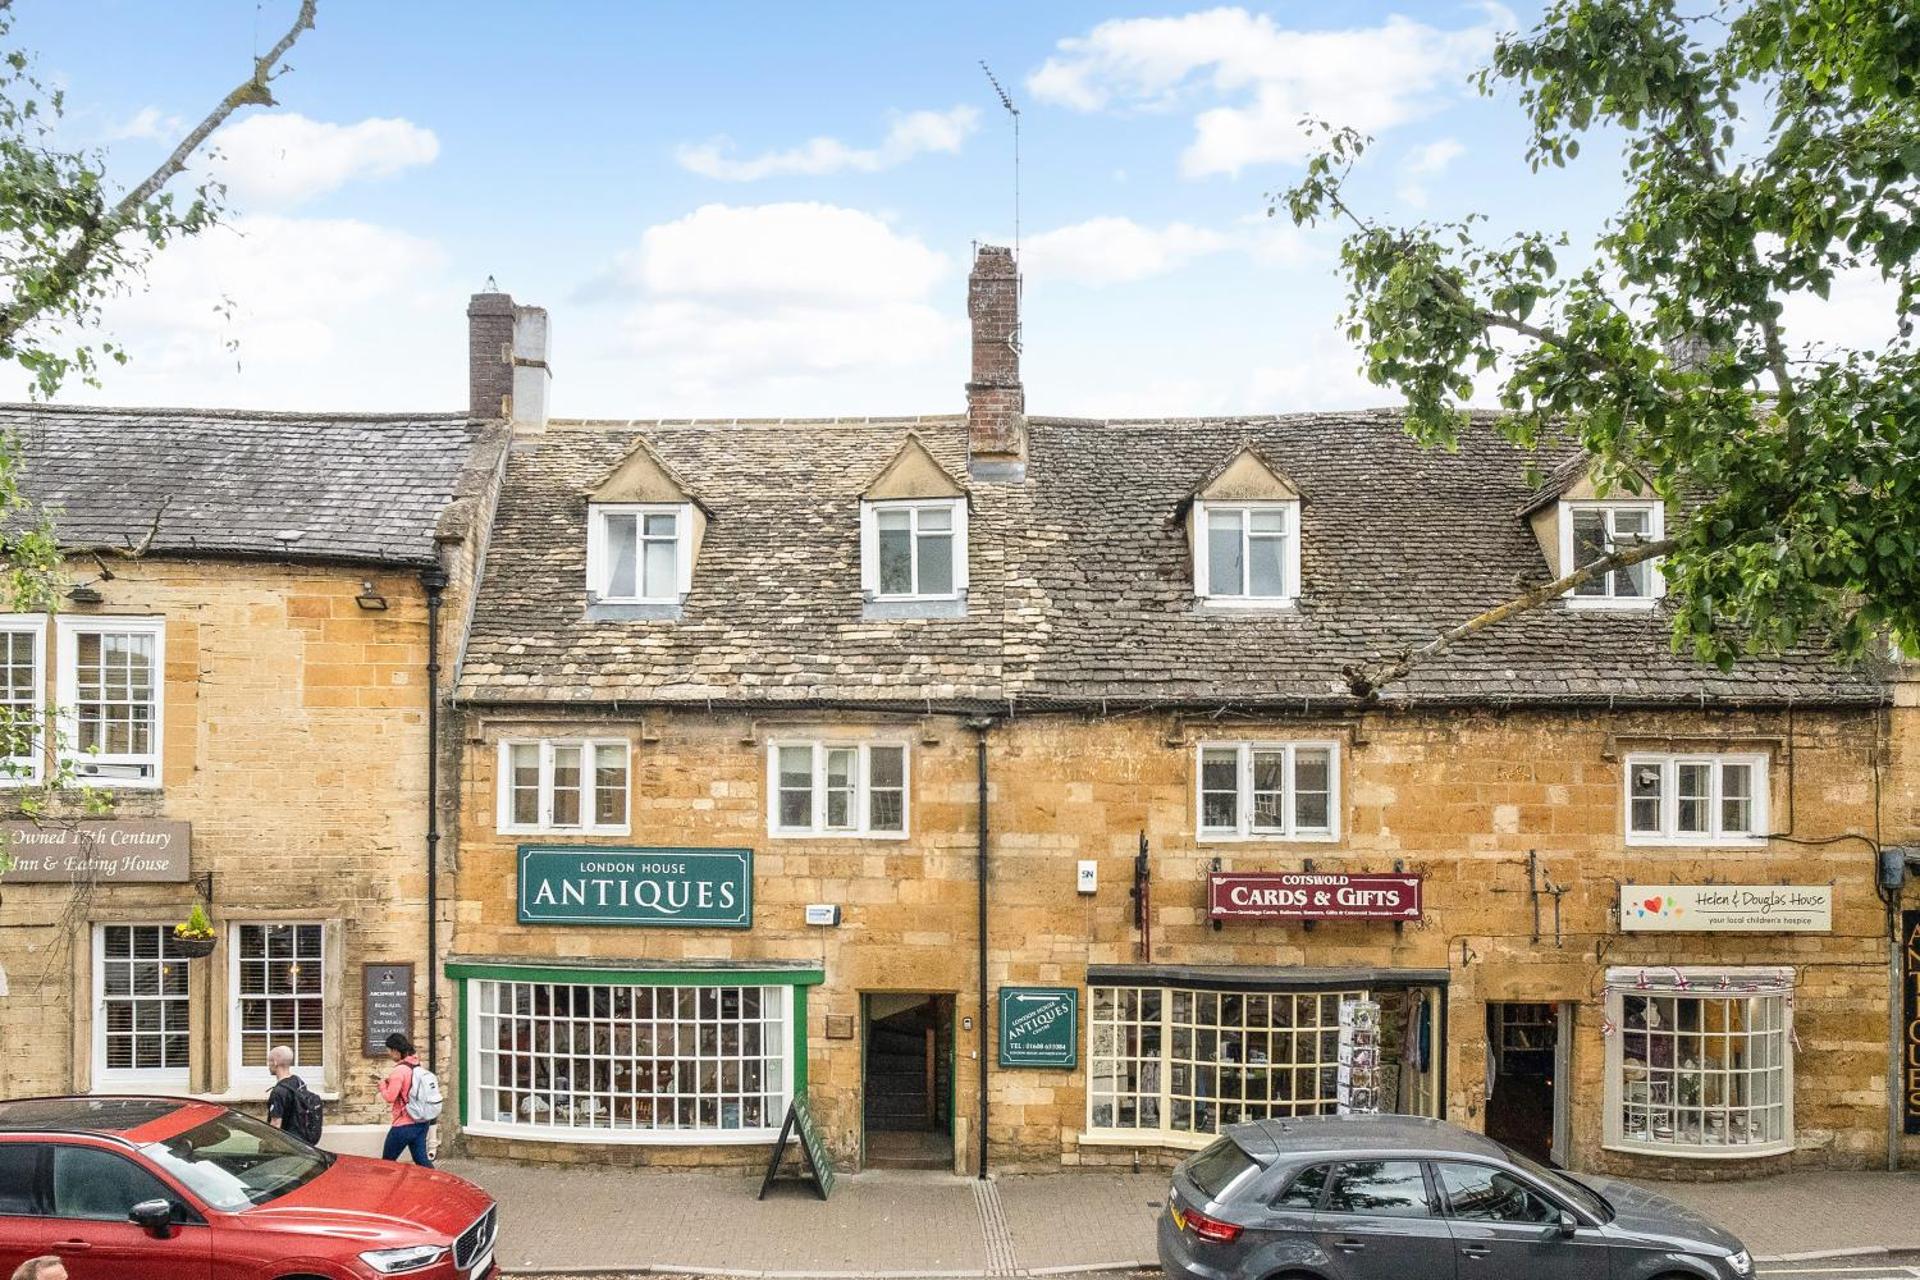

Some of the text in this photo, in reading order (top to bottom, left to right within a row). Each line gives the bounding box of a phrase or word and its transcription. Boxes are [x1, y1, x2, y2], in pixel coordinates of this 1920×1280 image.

[12, 828, 171, 849] Owned 17th Century
[11, 856, 38, 871] Inn
[43, 856, 58, 871] &
[64, 856, 117, 876] Eating
[121, 856, 170, 871] House
[580, 862, 686, 874] LONDON HOUSE
[1281, 875, 1349, 885] COTSWOLD
[532, 878, 735, 914] ANTIQUES
[1230, 887, 1400, 907] CARDS & GIFTS
[1696, 890, 1825, 914] Helen & Douglas House
[1784, 917, 1812, 925] hospice
[1009, 1003, 1069, 1040] ANTIQUES
